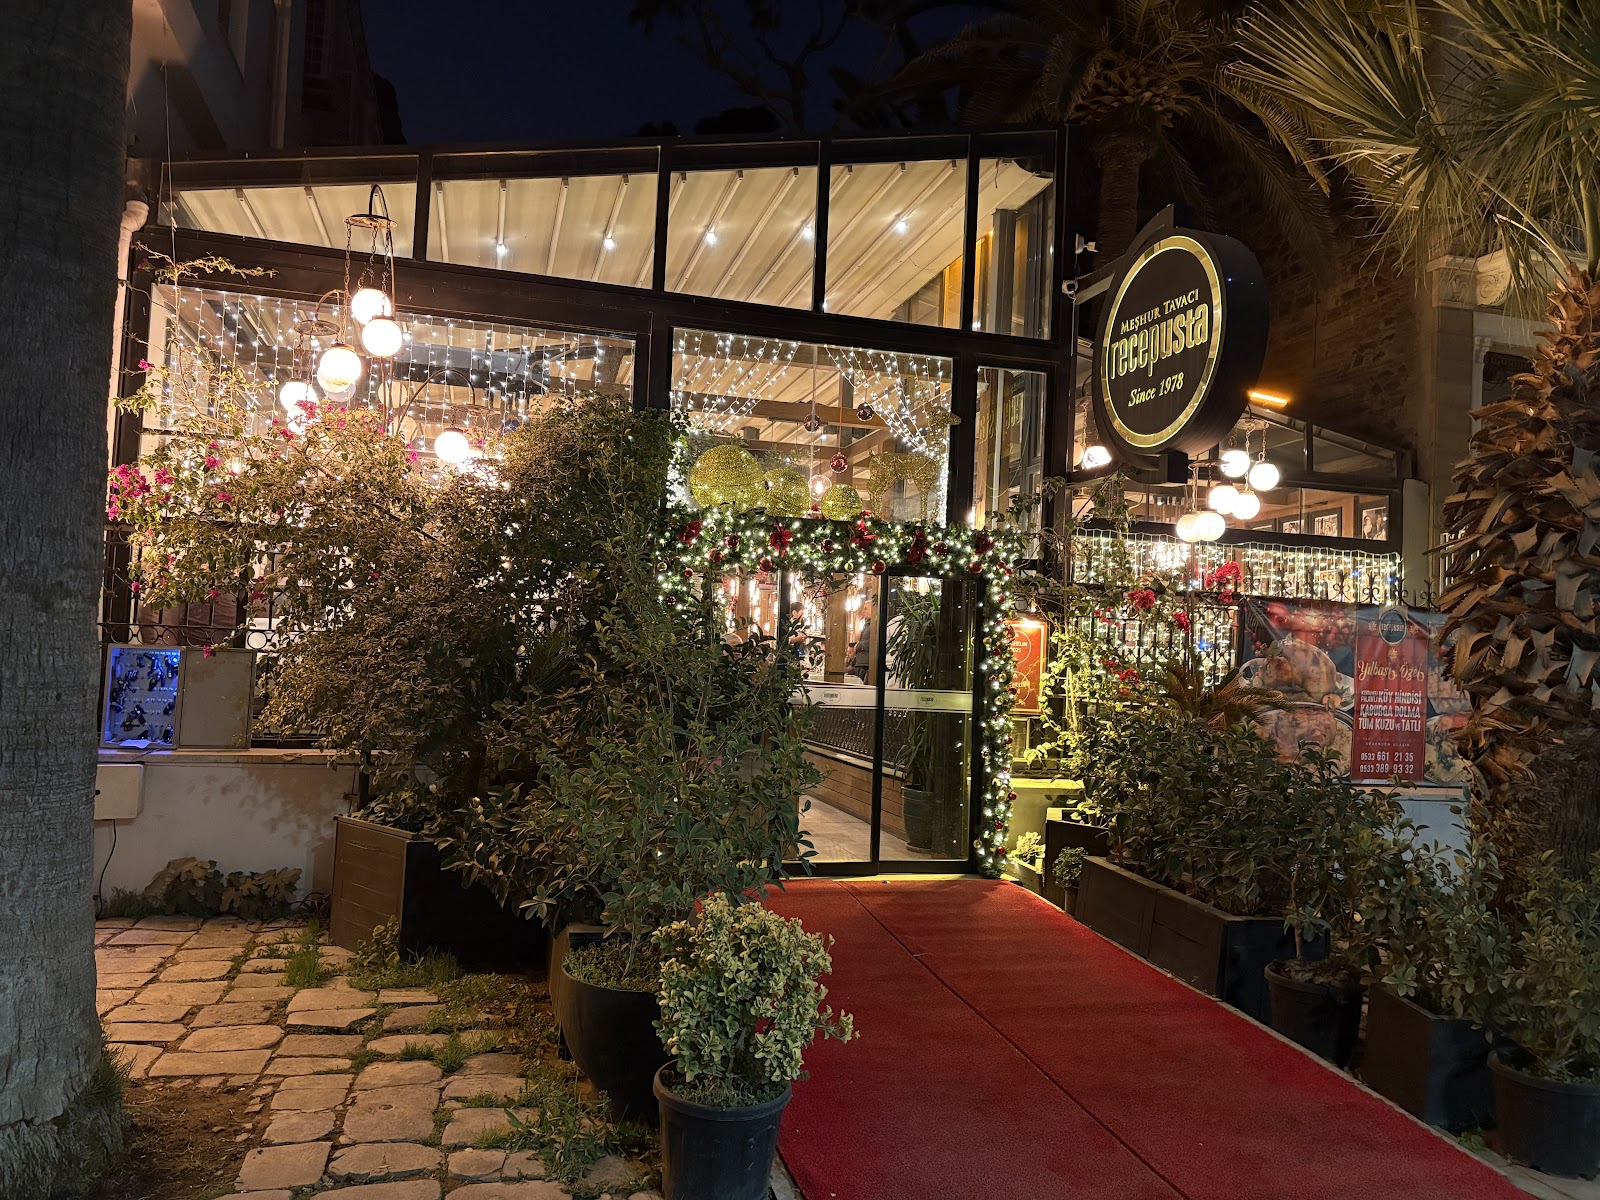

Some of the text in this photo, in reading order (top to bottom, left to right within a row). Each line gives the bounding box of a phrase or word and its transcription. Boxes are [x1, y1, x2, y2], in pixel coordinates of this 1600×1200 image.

[1120, 288, 1199, 334] MEŞHUR TAVACI
[1110, 303, 1209, 380] recepusta
[1128, 372, 1184, 407] Since 1978
[1399, 662, 1425, 682] Özel
[1378, 688, 1393, 703] KÖY
[1394, 689, 1422, 705] HİNDİSİ
[1360, 704, 1421, 718] KABURGA DOLMA
[1375, 718, 1395, 731] KUZU
[1401, 719, 1421, 732] TATLI
[1360, 751, 1414, 762] 0533 661 21 35
[1359, 763, 1414, 774] 0533 389 93 32
